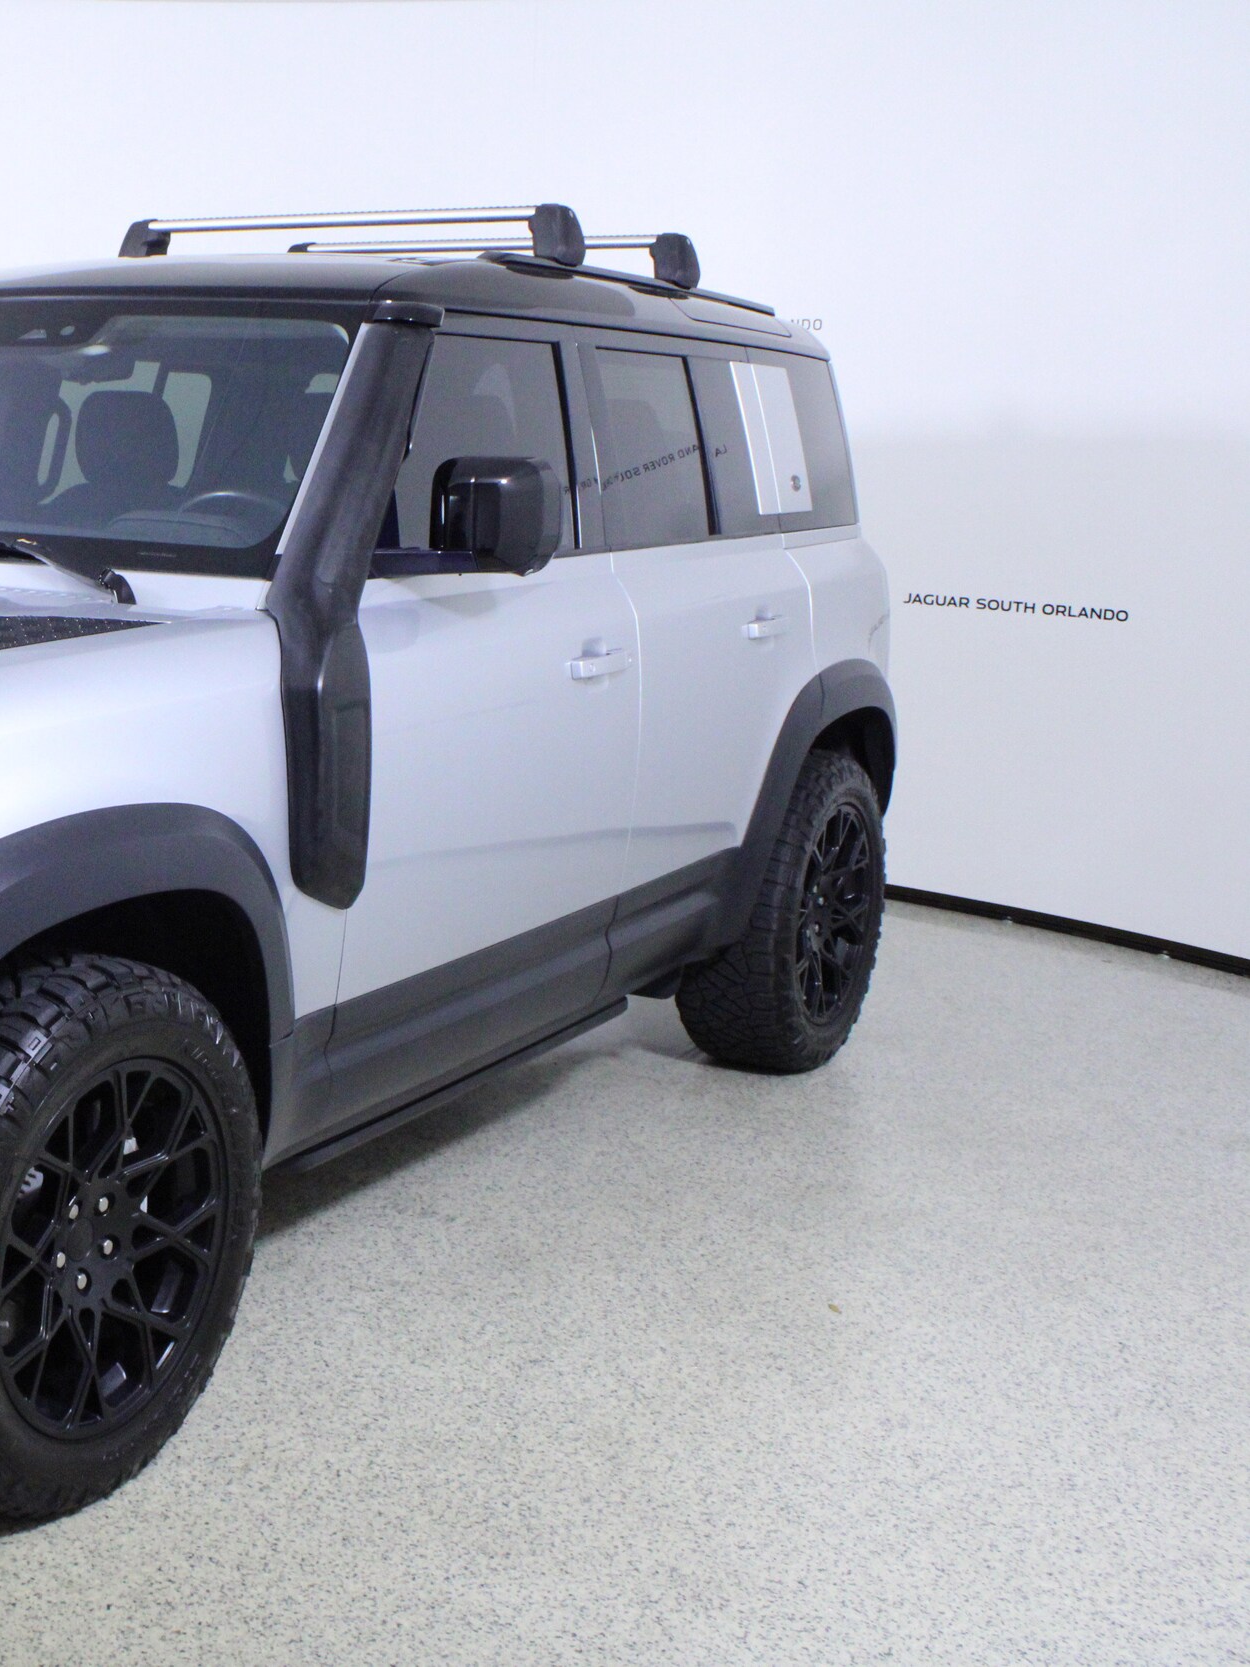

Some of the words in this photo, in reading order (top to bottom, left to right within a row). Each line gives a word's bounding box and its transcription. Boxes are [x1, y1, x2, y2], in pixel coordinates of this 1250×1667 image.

[903, 593, 970, 609] JAGUAR
[976, 598, 1036, 614] SOUTH
[1042, 603, 1129, 622] ORLANDO
